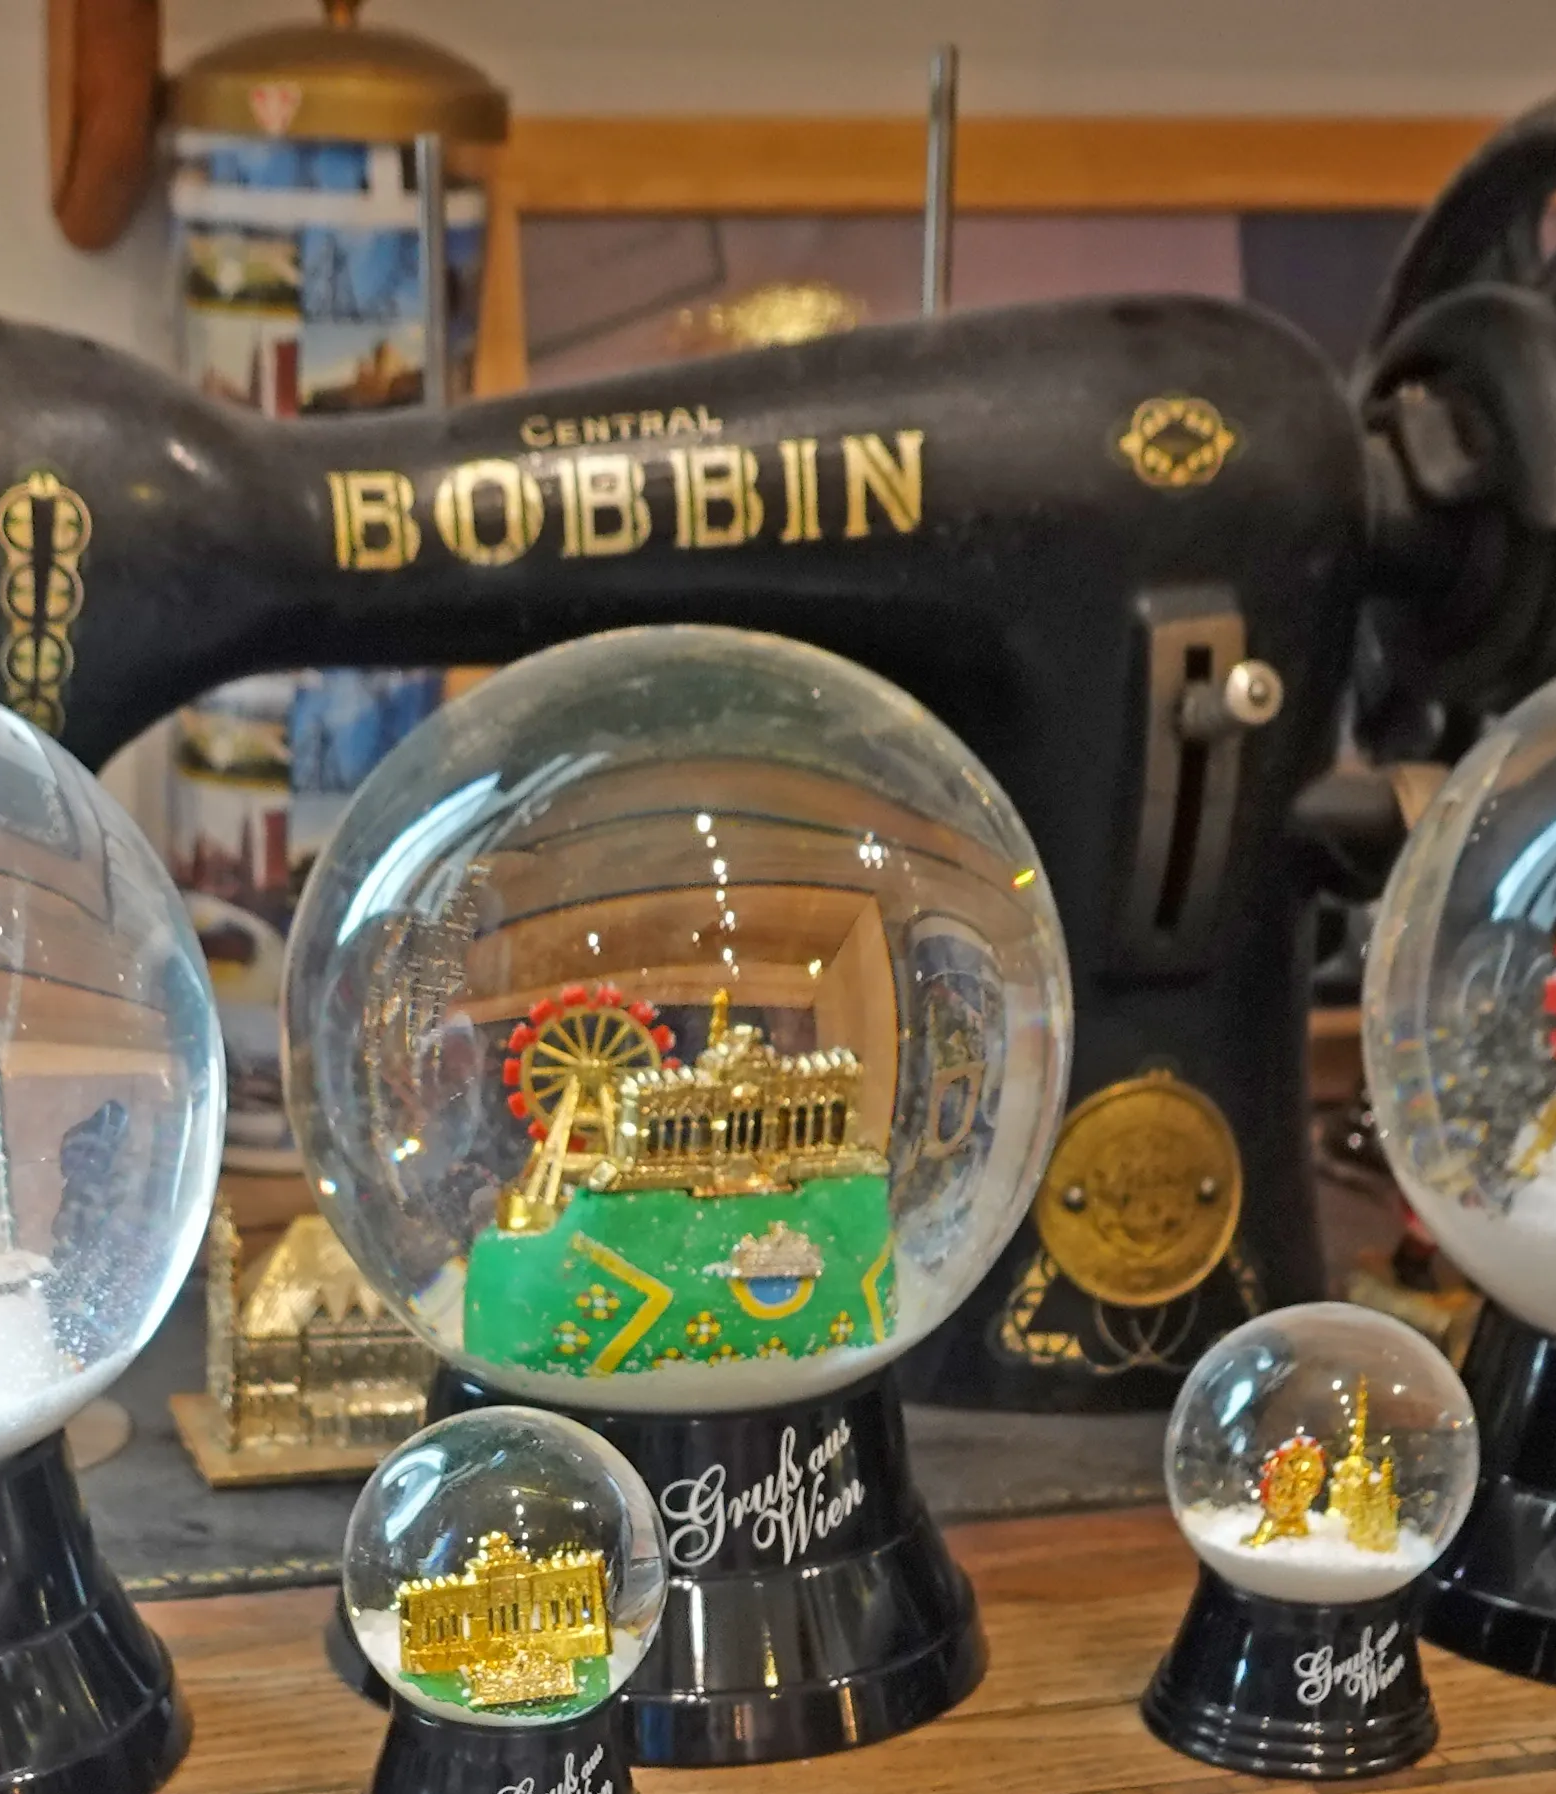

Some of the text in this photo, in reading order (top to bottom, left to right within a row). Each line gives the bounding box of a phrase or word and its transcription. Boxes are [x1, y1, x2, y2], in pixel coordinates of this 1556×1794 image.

[519, 405, 723, 448] CENTRAL
[327, 430, 925, 571] BOBBIN
[659, 1416, 851, 1568] Gruß aus
[752, 1471, 865, 1565] Wien
